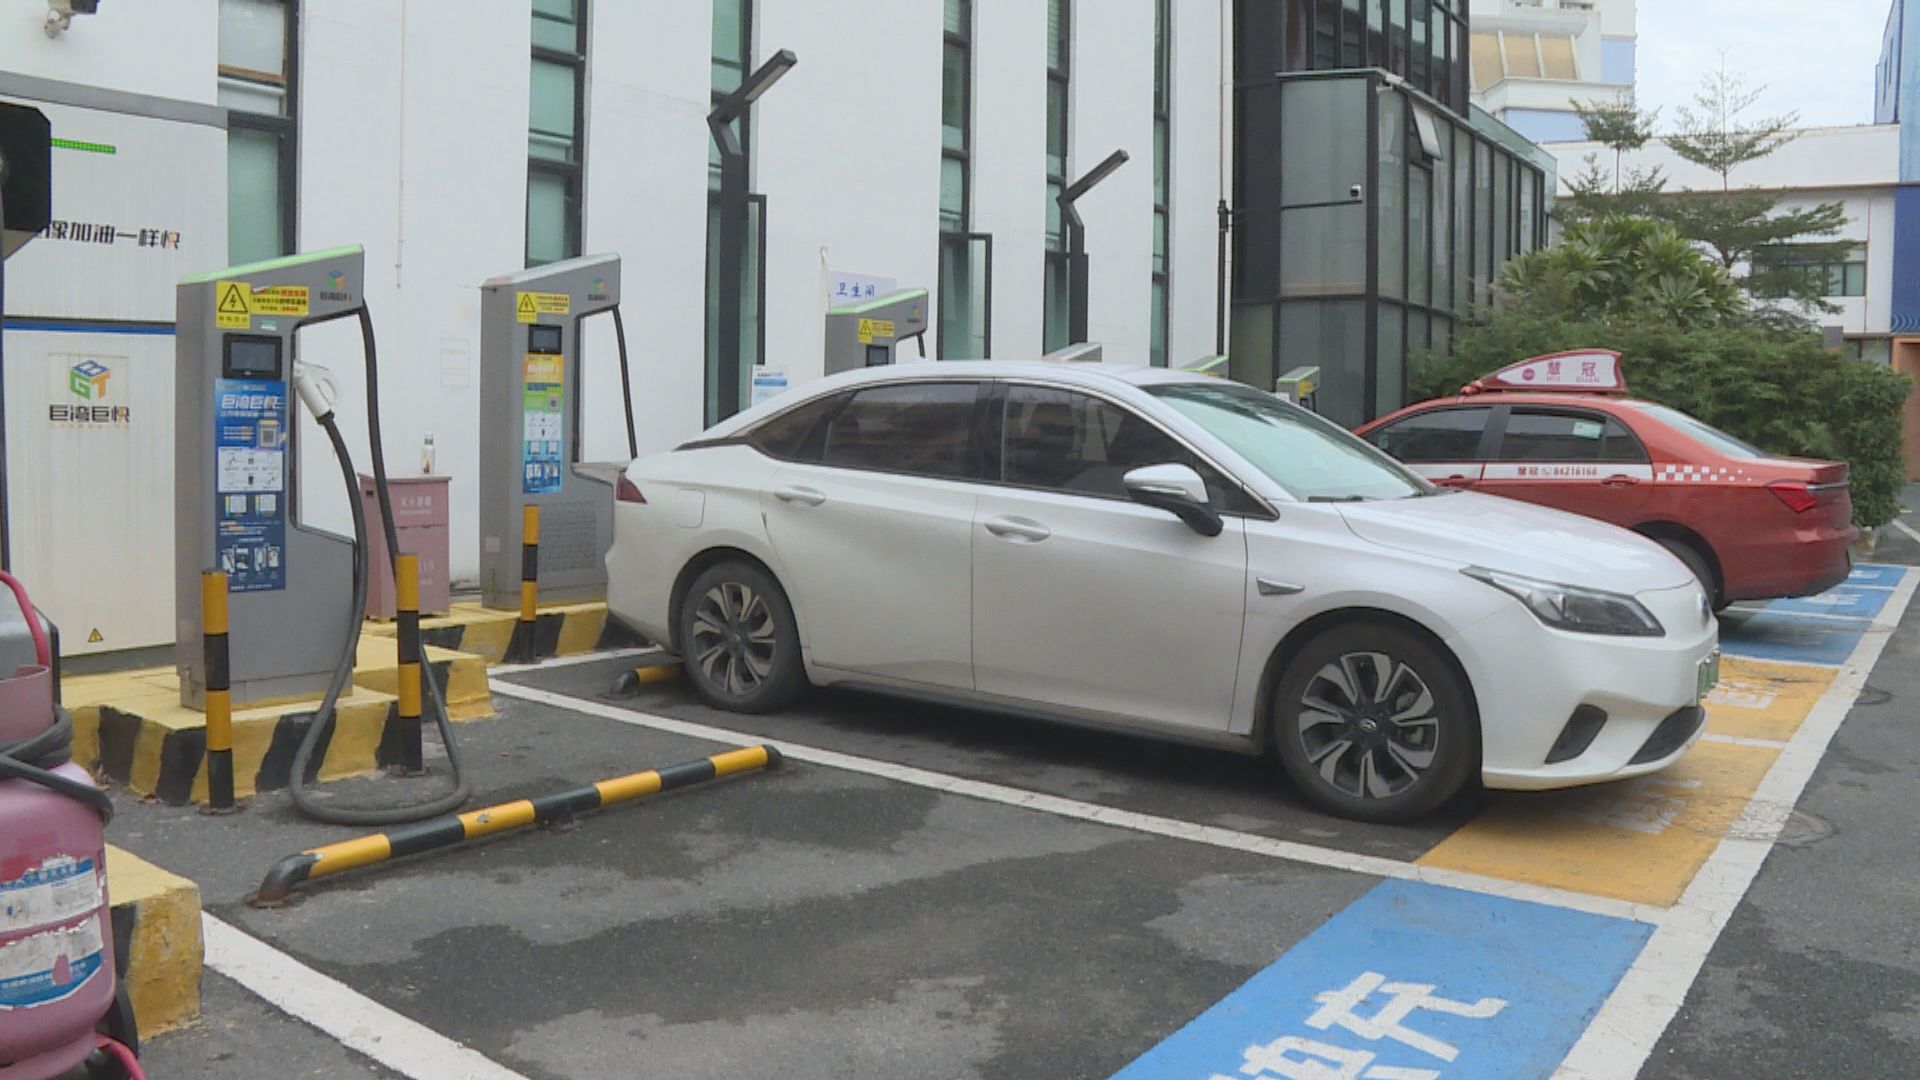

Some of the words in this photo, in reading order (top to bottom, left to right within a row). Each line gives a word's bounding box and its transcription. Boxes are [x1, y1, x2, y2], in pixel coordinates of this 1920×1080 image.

[38, 219, 181, 250] 像加油一样快
[836, 281, 875, 299] 卫生间
[49, 404, 130, 423] 巨湾巨快
